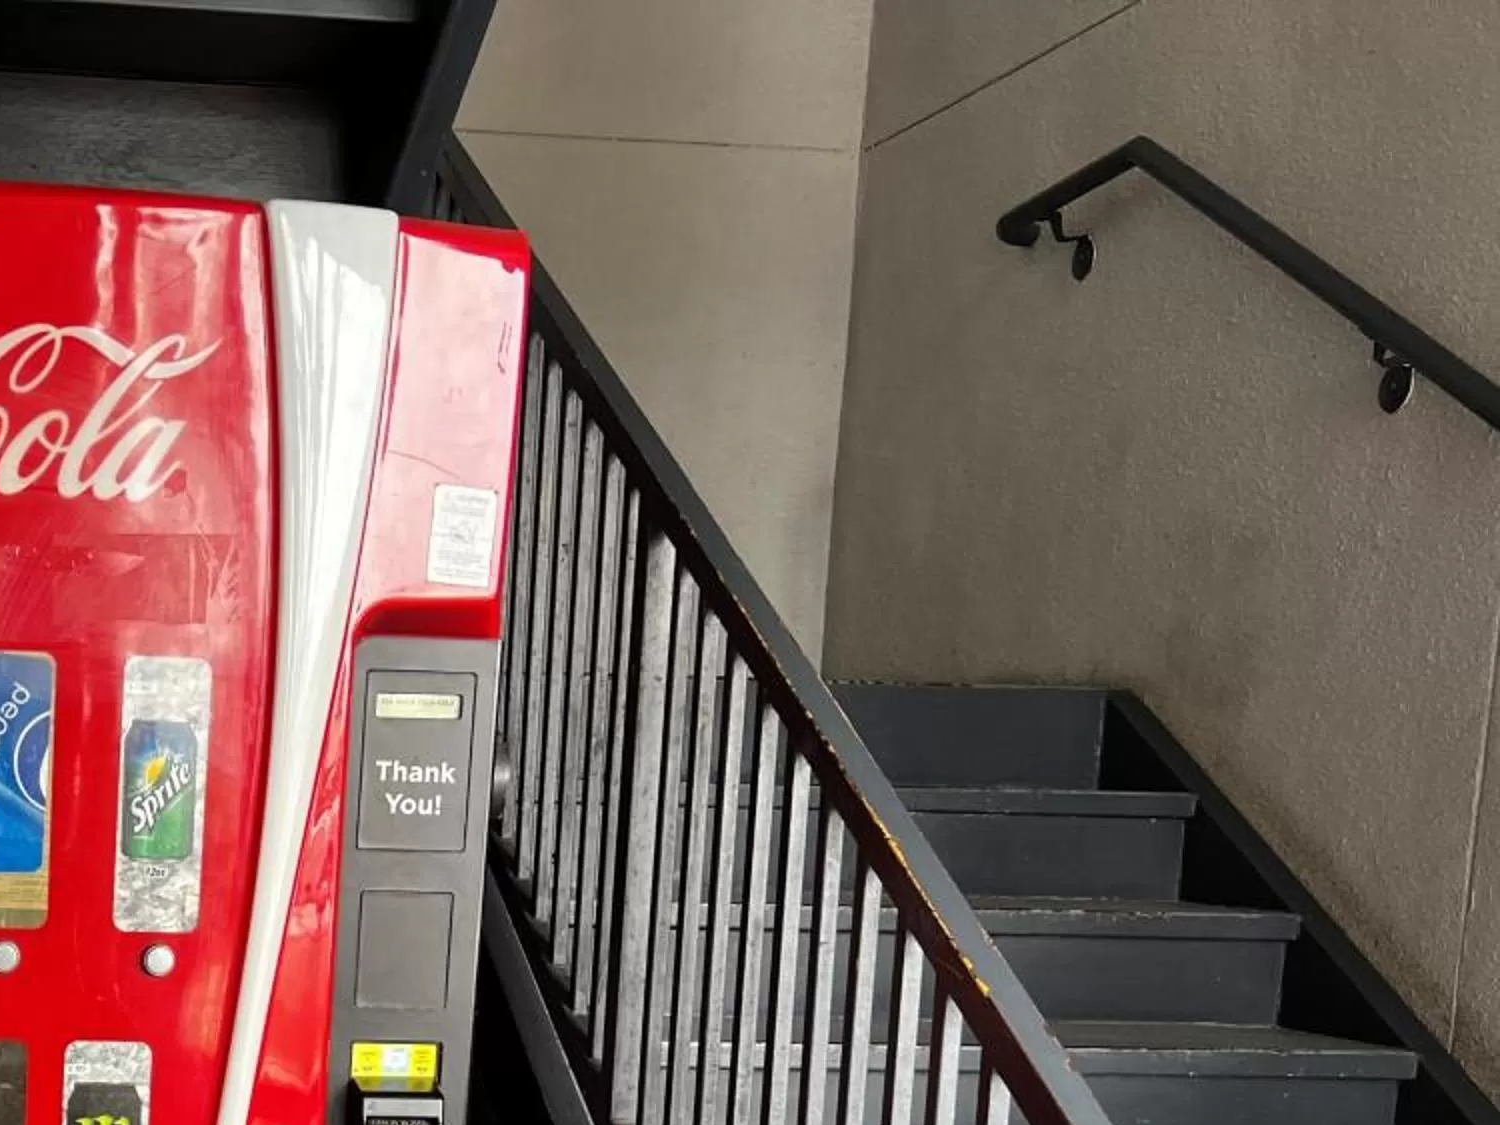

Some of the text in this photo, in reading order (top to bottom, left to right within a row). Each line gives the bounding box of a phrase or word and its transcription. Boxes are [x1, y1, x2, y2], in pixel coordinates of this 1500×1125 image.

[375, 760, 456, 784] Thank
[131, 752, 190, 833] Sprite
[385, 793, 442, 816] You!
